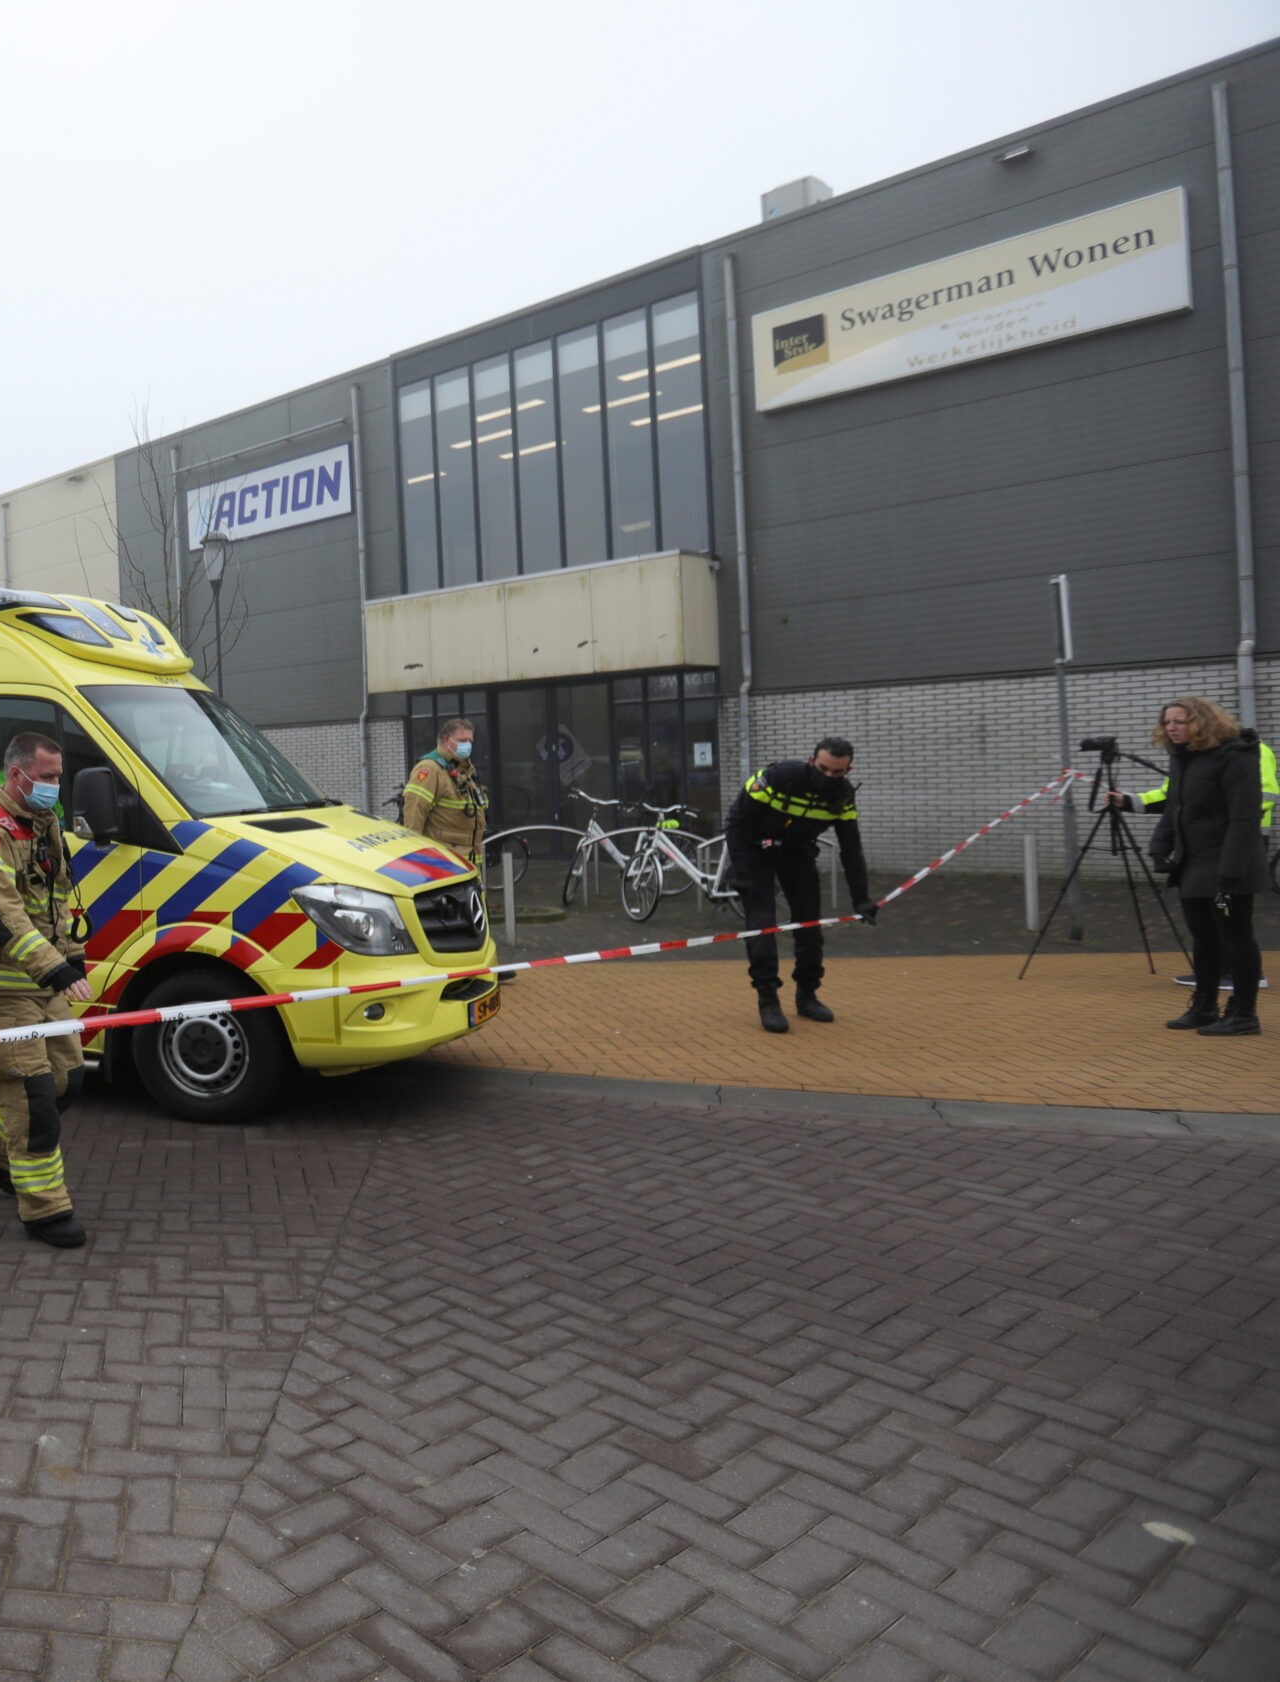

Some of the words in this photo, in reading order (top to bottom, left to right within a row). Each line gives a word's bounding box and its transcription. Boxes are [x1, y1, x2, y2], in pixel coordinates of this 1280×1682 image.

[840, 267, 1016, 333] Swagerman
[1027, 227, 1157, 279] Wonen
[213, 460, 343, 532] ACTION
